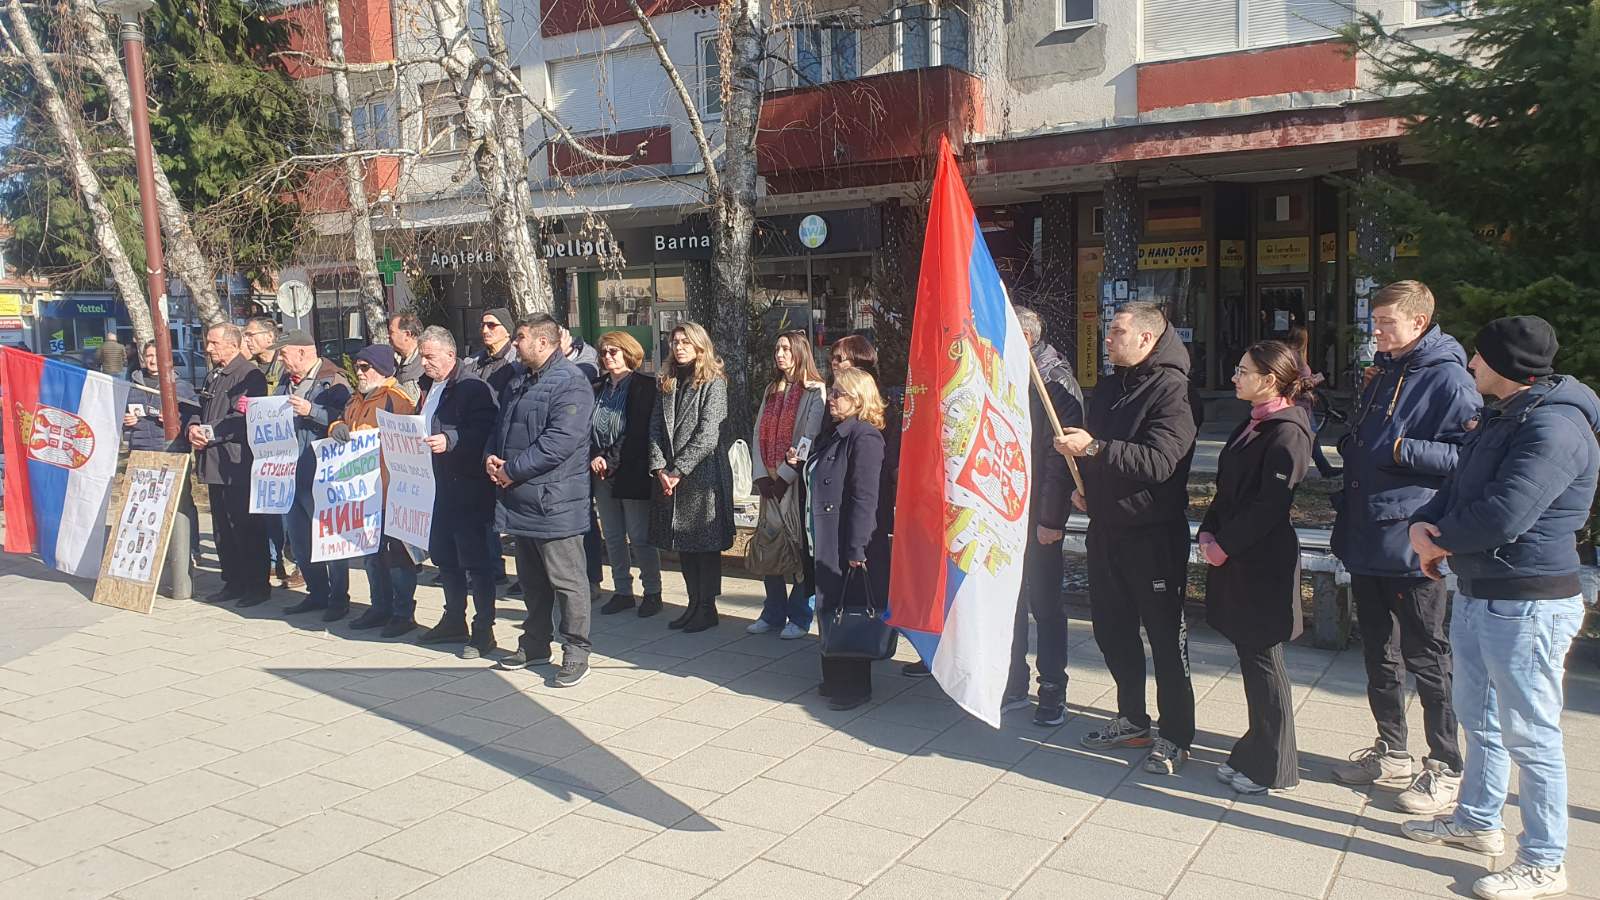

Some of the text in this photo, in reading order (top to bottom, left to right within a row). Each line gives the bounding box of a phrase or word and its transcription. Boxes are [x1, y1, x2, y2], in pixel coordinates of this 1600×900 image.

[430, 251, 493, 269] Apoteka
[1148, 247, 1176, 258] HAND
[1176, 245, 1204, 257] SHOP
[254, 420, 294, 444] ДЕДА
[322, 434, 375, 462] АКО ВАМ
[319, 455, 377, 483] ЈЕ ДОБРО
[327, 479, 367, 504] ОНДА
